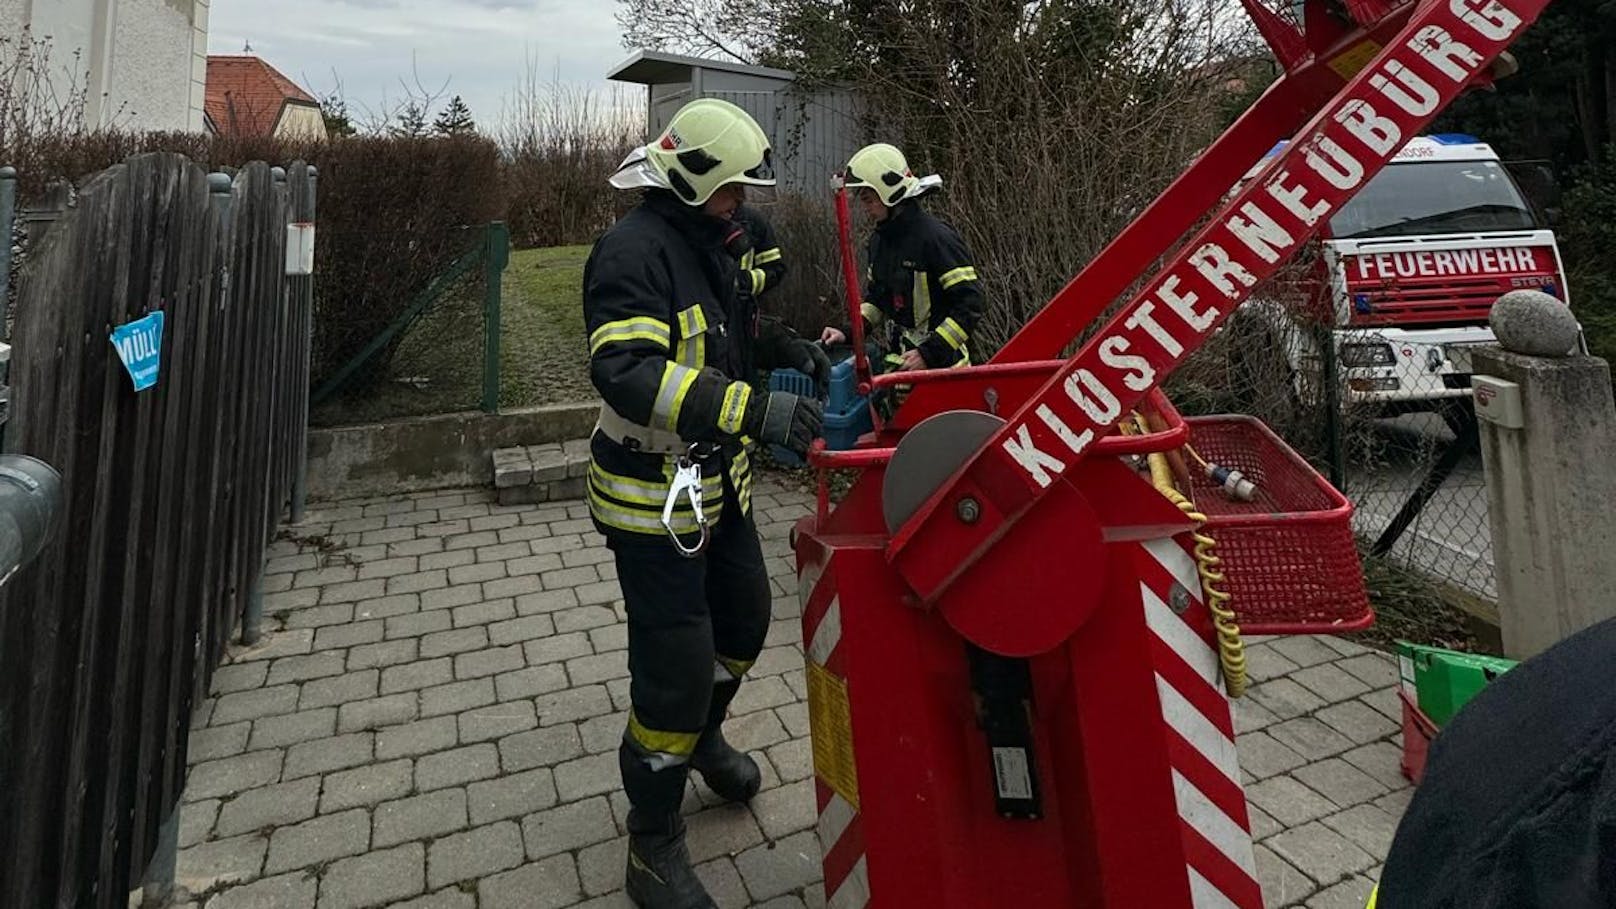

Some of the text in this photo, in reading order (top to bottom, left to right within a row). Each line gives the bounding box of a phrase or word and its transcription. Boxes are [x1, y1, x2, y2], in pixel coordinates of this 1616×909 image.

[1395, 147, 1434, 158] NDORF
[1002, 0, 1522, 488] KLOSTERNEUBURG
[1357, 247, 1537, 279] FEUERWEHR
[1511, 276, 1555, 287] STEYR
